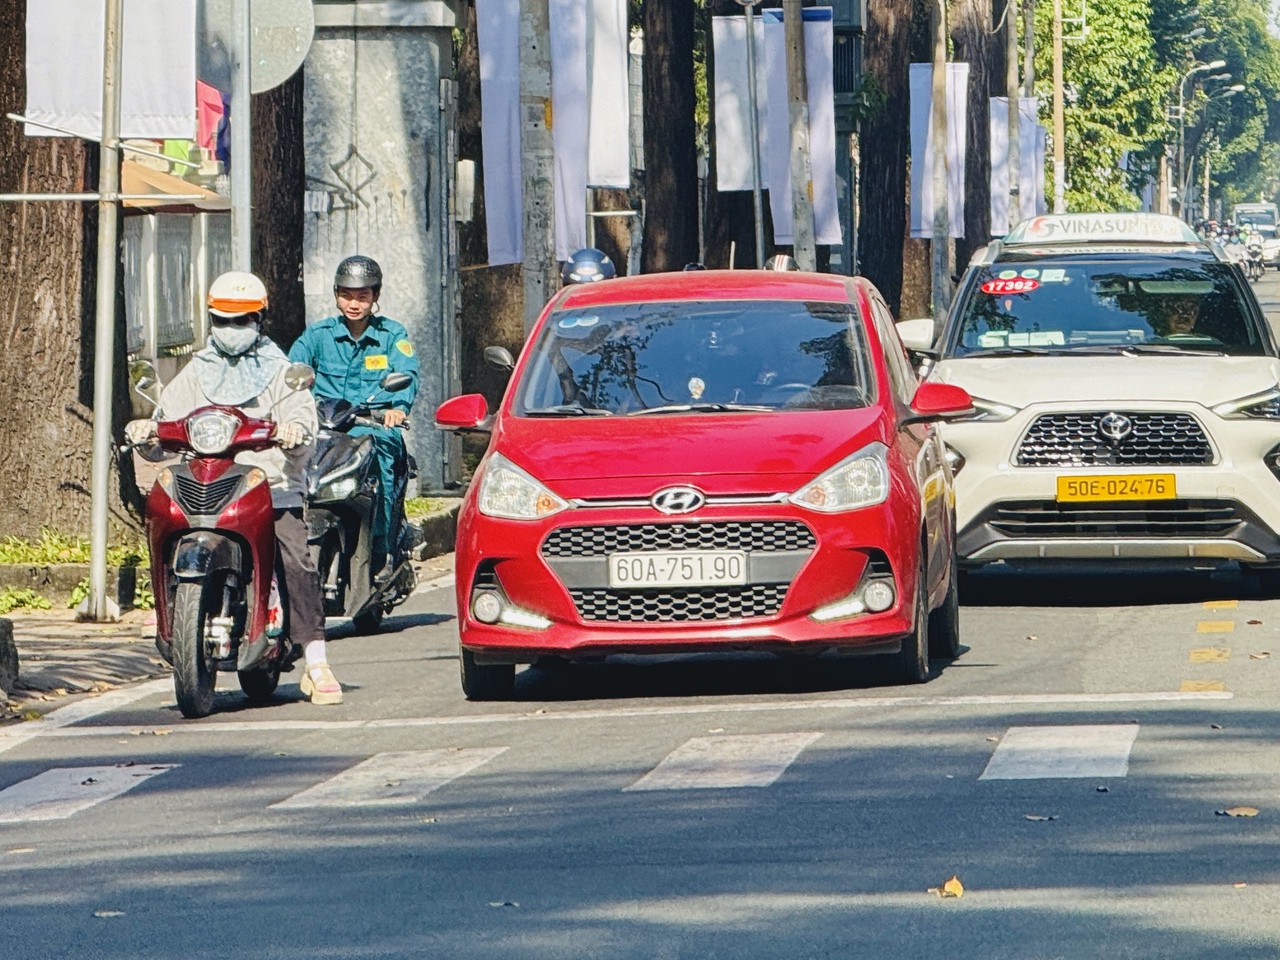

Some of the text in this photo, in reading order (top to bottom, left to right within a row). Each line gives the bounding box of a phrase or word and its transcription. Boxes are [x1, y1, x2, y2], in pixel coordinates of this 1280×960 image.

[1059, 218, 1140, 234] VINASUN
[1067, 479, 1165, 496] 50E-024.76
[616, 556, 740, 582] 60A-751.90
